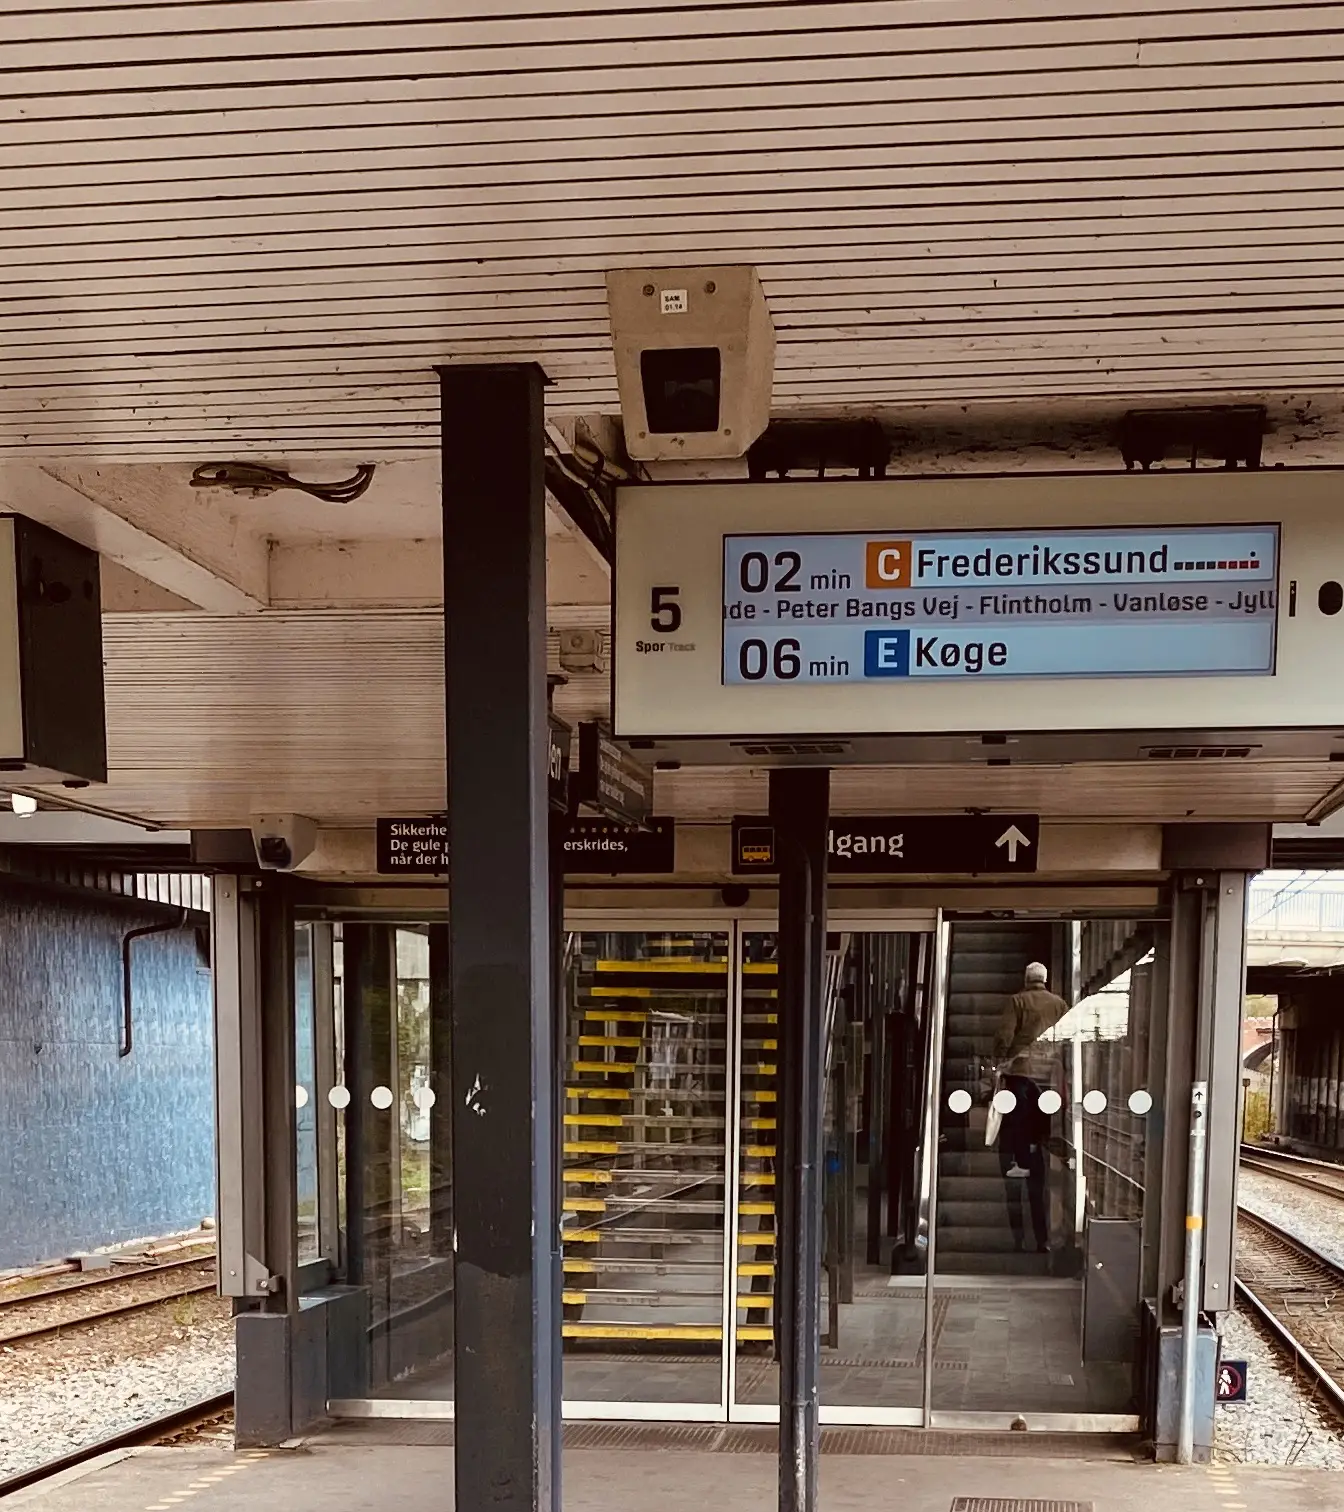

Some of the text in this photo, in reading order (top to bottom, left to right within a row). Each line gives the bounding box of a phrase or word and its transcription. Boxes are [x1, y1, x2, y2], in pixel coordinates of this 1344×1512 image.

[739, 544, 1168, 593] 02 min C Frederikssund
[650, 586, 682, 633] 5
[777, 600, 839, 619] Peter
[846, 598, 916, 621] Bangs
[922, 594, 959, 619] Vej
[980, 594, 1092, 616] Flintholm
[1113, 592, 1209, 612] Vanløse
[635, 640, 666, 655] Spor
[739, 636, 1008, 681] 06 min E Køge
[390, 823, 448, 836] Sikkerhe
[390, 839, 409, 851] De
[412, 838, 441, 853] gule
[563, 838, 629, 852] erskrides,
[828, 829, 904, 859] gang
[390, 852, 413, 865] når
[415, 853, 438, 865] der
